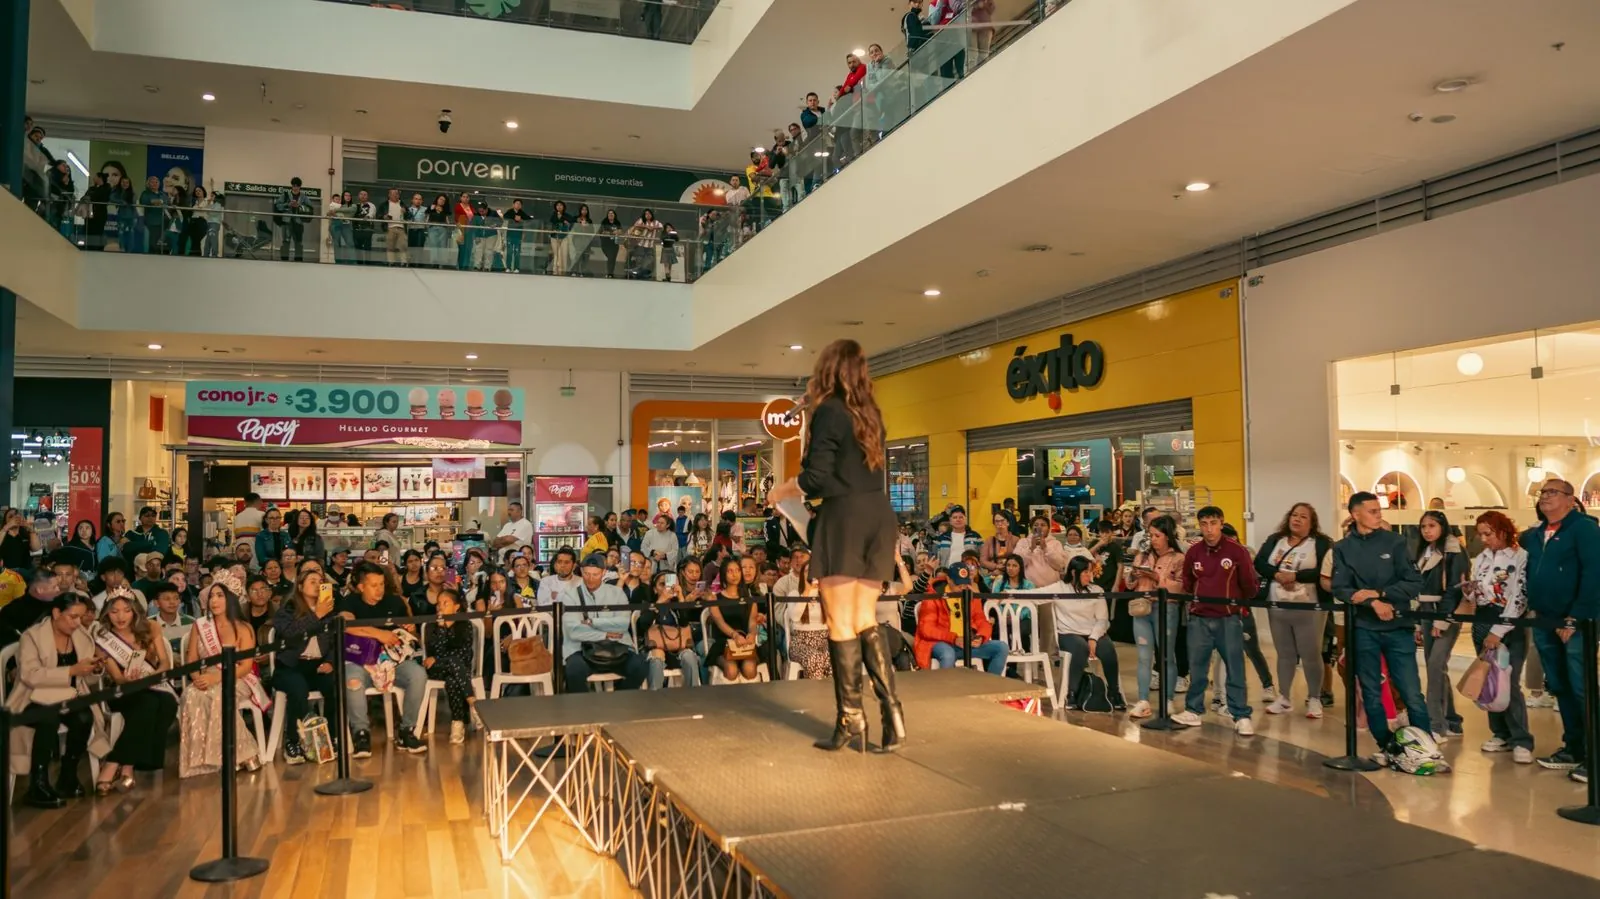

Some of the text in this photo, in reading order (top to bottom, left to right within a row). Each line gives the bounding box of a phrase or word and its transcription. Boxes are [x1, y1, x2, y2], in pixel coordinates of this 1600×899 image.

[161, 153, 190, 161] BELLEZA
[416, 158, 521, 181] porvenir
[554, 173, 597, 184] pensiones
[606, 177, 644, 188] cesantías
[245, 184, 267, 193] Salida
[1006, 333, 1105, 410] éxito
[198, 390, 246, 402] cono
[237, 418, 300, 447] Popsy
[339, 424, 429, 433] HELADO GOURMET
[71, 471, 100, 484] 50%
[548, 484, 575, 497] Popsy
